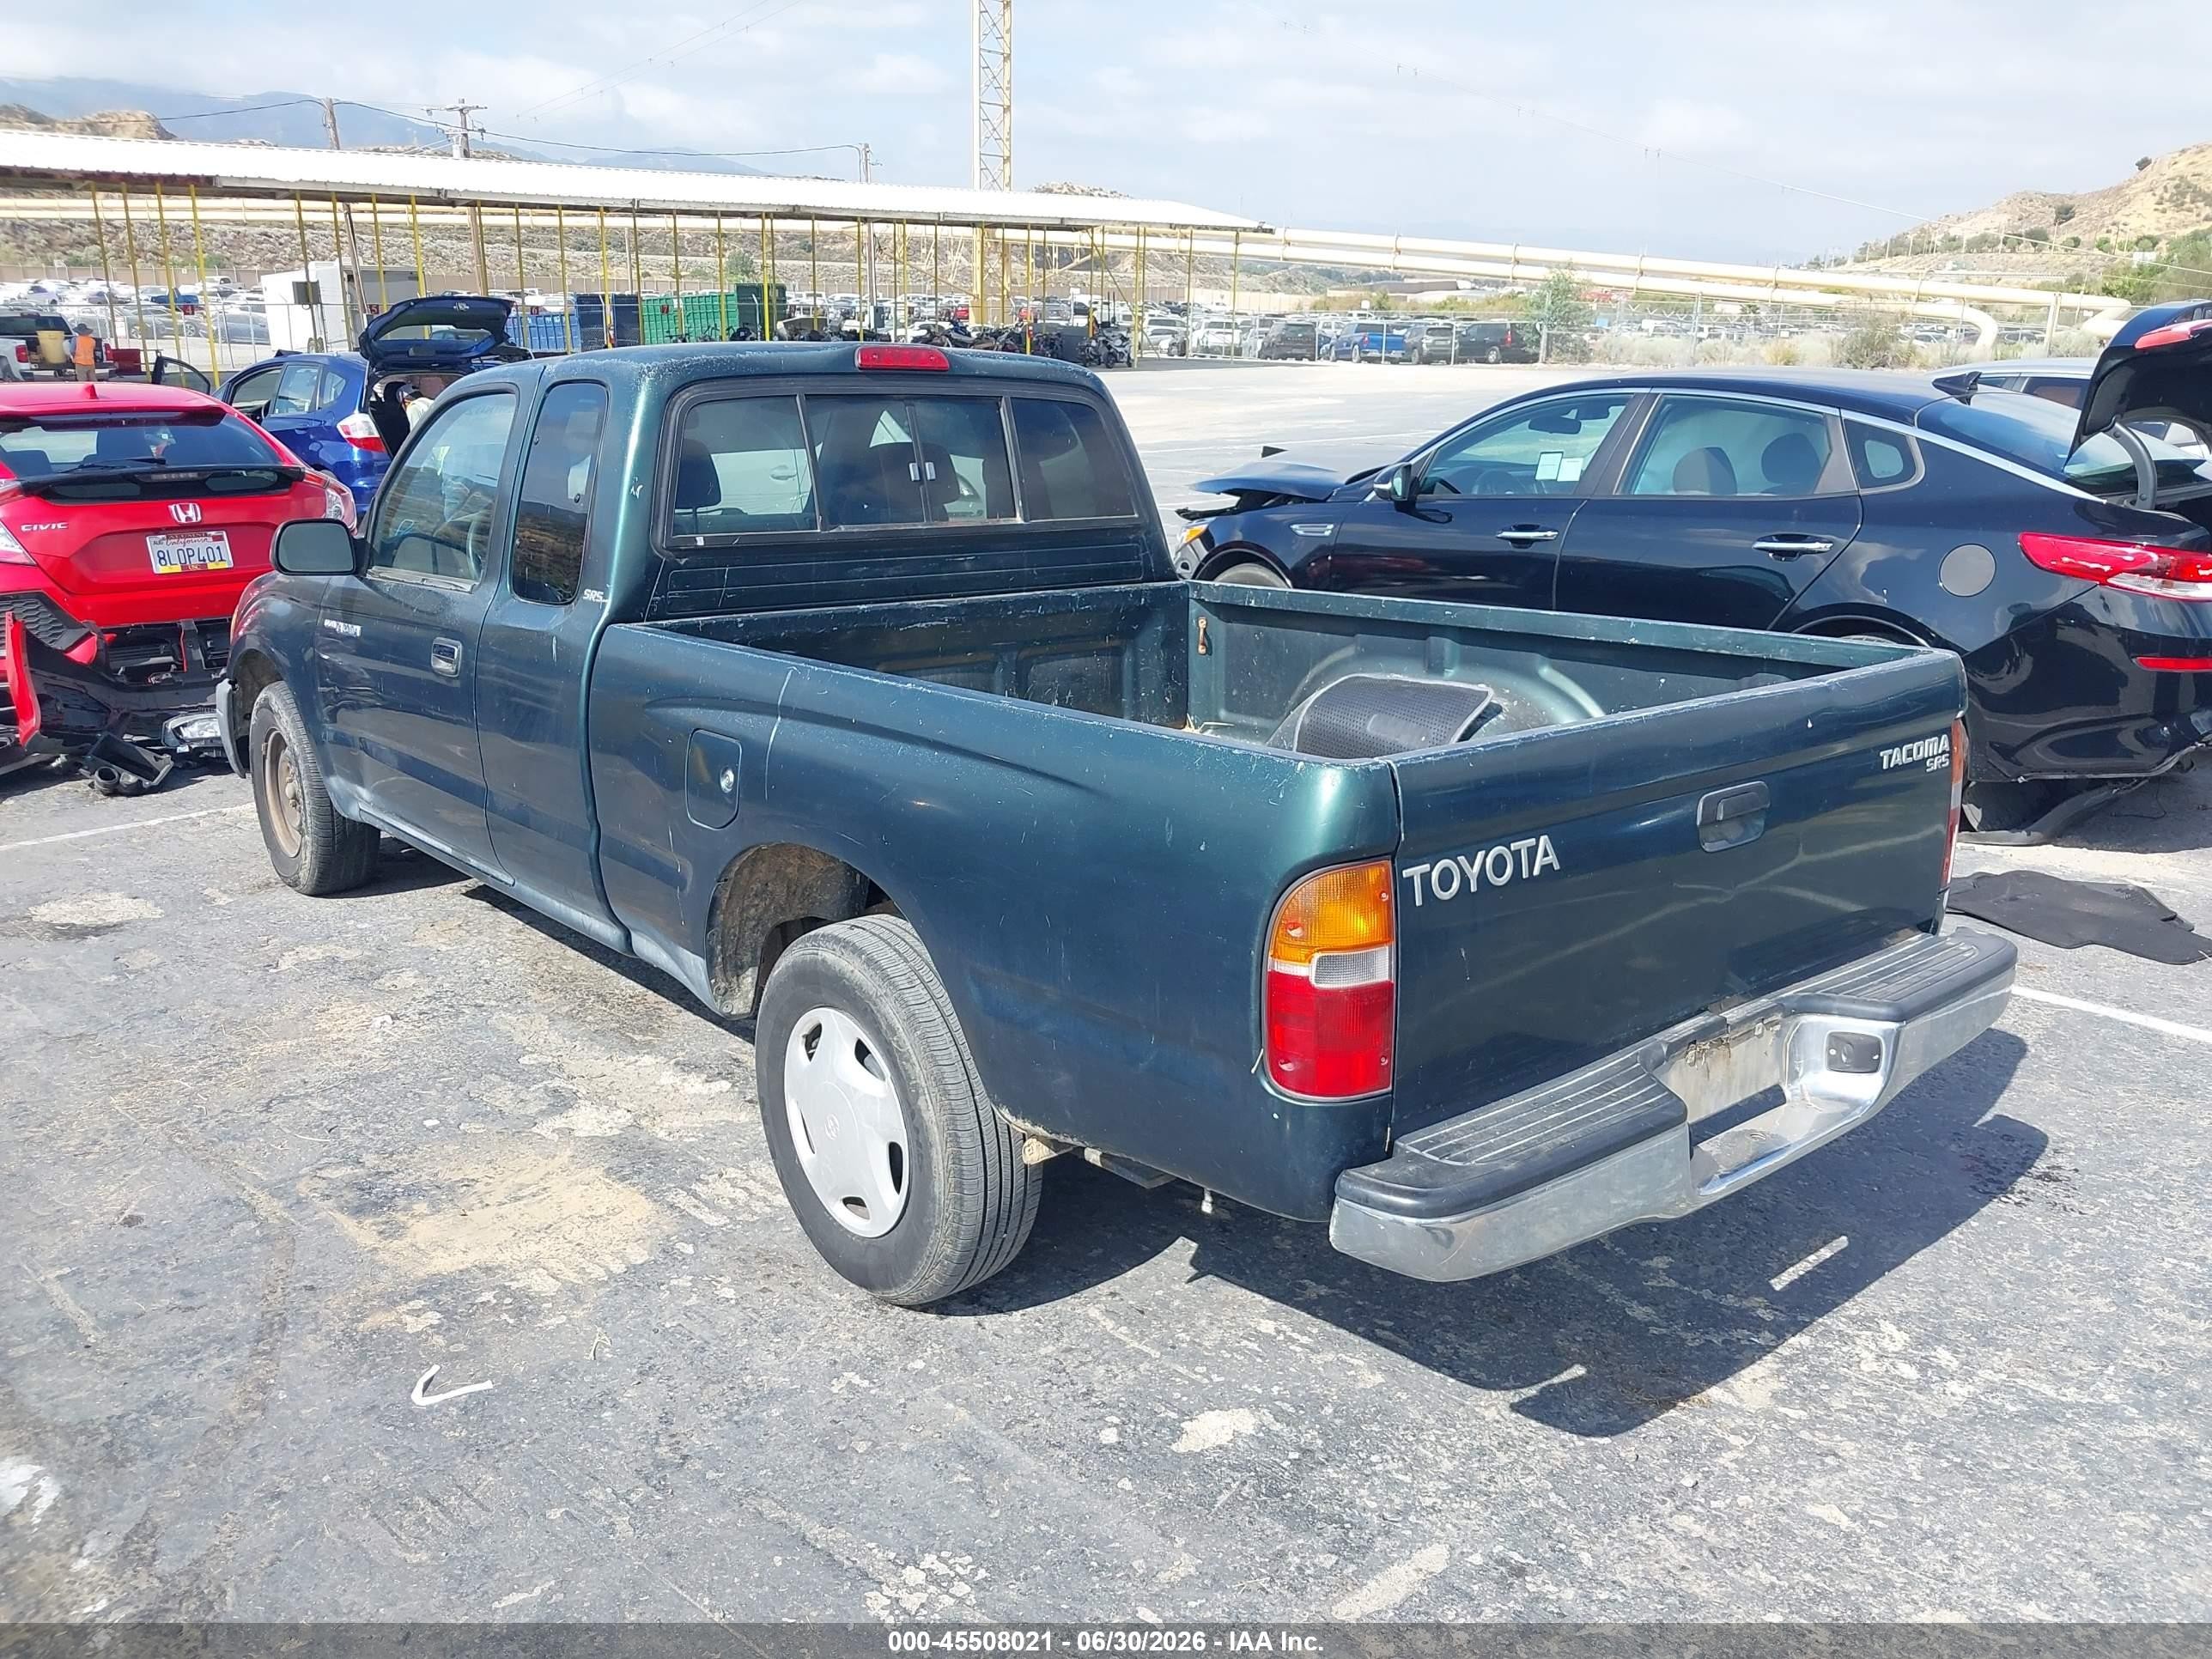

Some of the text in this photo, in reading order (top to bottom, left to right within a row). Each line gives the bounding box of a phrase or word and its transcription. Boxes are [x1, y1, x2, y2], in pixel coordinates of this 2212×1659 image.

[21, 522, 69, 532] CIVIC
[1879, 733, 1950, 770] TACOMA
[1925, 753, 1950, 773] SR5
[1401, 834, 1561, 907] TOYOTA
